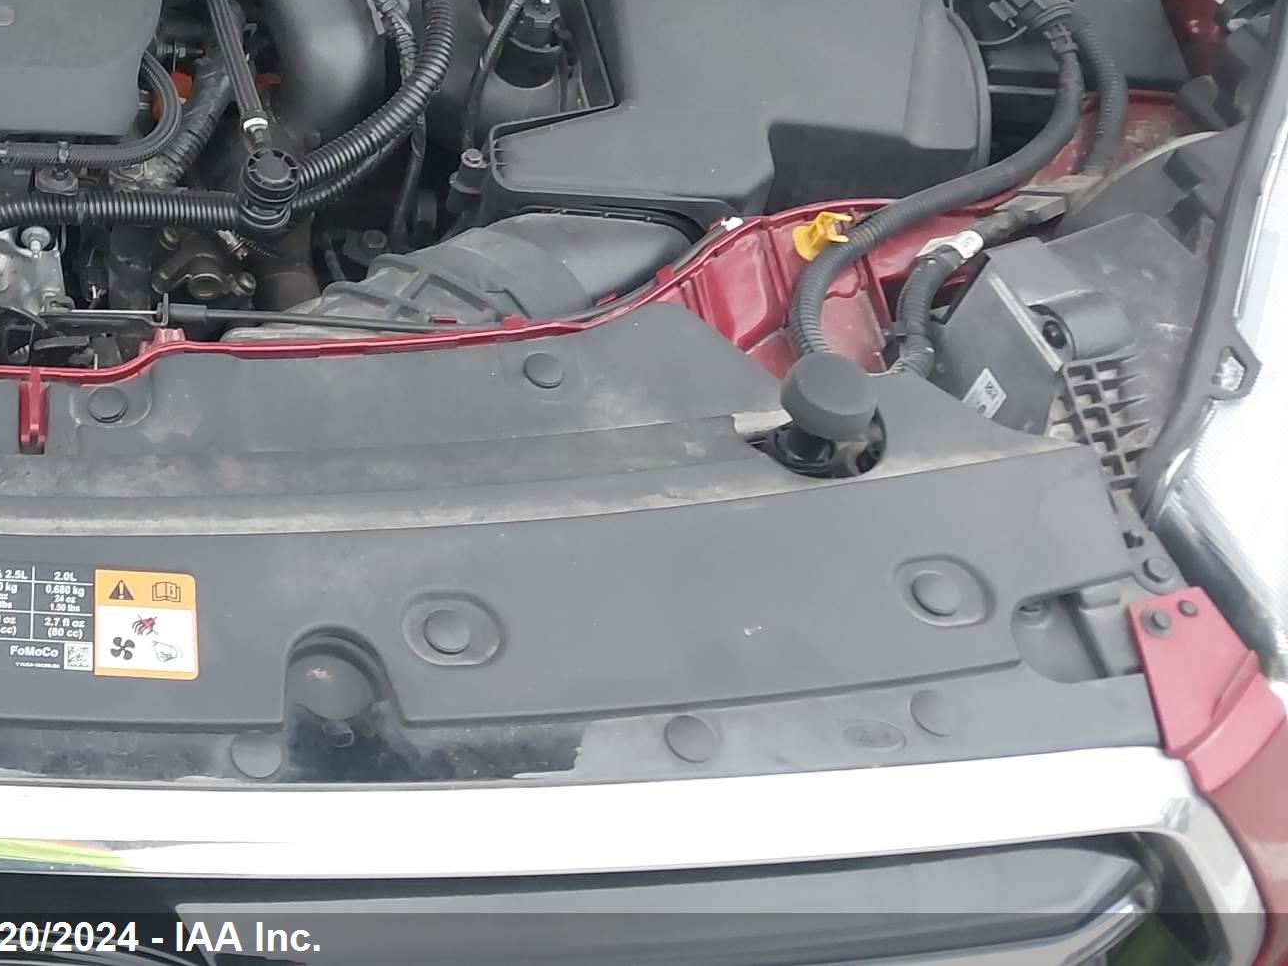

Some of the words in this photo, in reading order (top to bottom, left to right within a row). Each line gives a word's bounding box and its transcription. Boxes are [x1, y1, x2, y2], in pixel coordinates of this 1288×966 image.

[4, 569, 29, 580] 2.5L
[53, 571, 78, 582] 2.0L
[5, 582, 18, 594] kg
[45, 584, 71, 595] 0.680
[72, 585, 86, 597] kg
[0, 599, 13, 609] lbs
[53, 594, 65, 604] 24
[65, 596, 77, 604] oz
[49, 602, 67, 612] 1.50
[67, 603, 81, 613] lbs
[2, 615, 17, 625] oz
[44, 616, 60, 627] 2.7
[61, 617, 71, 627] fl
[71, 619, 86, 628] oz
[0, 625, 18, 636] cc)
[65, 628, 84, 640] cc)
[9, 644, 60, 657] FoMoCo
